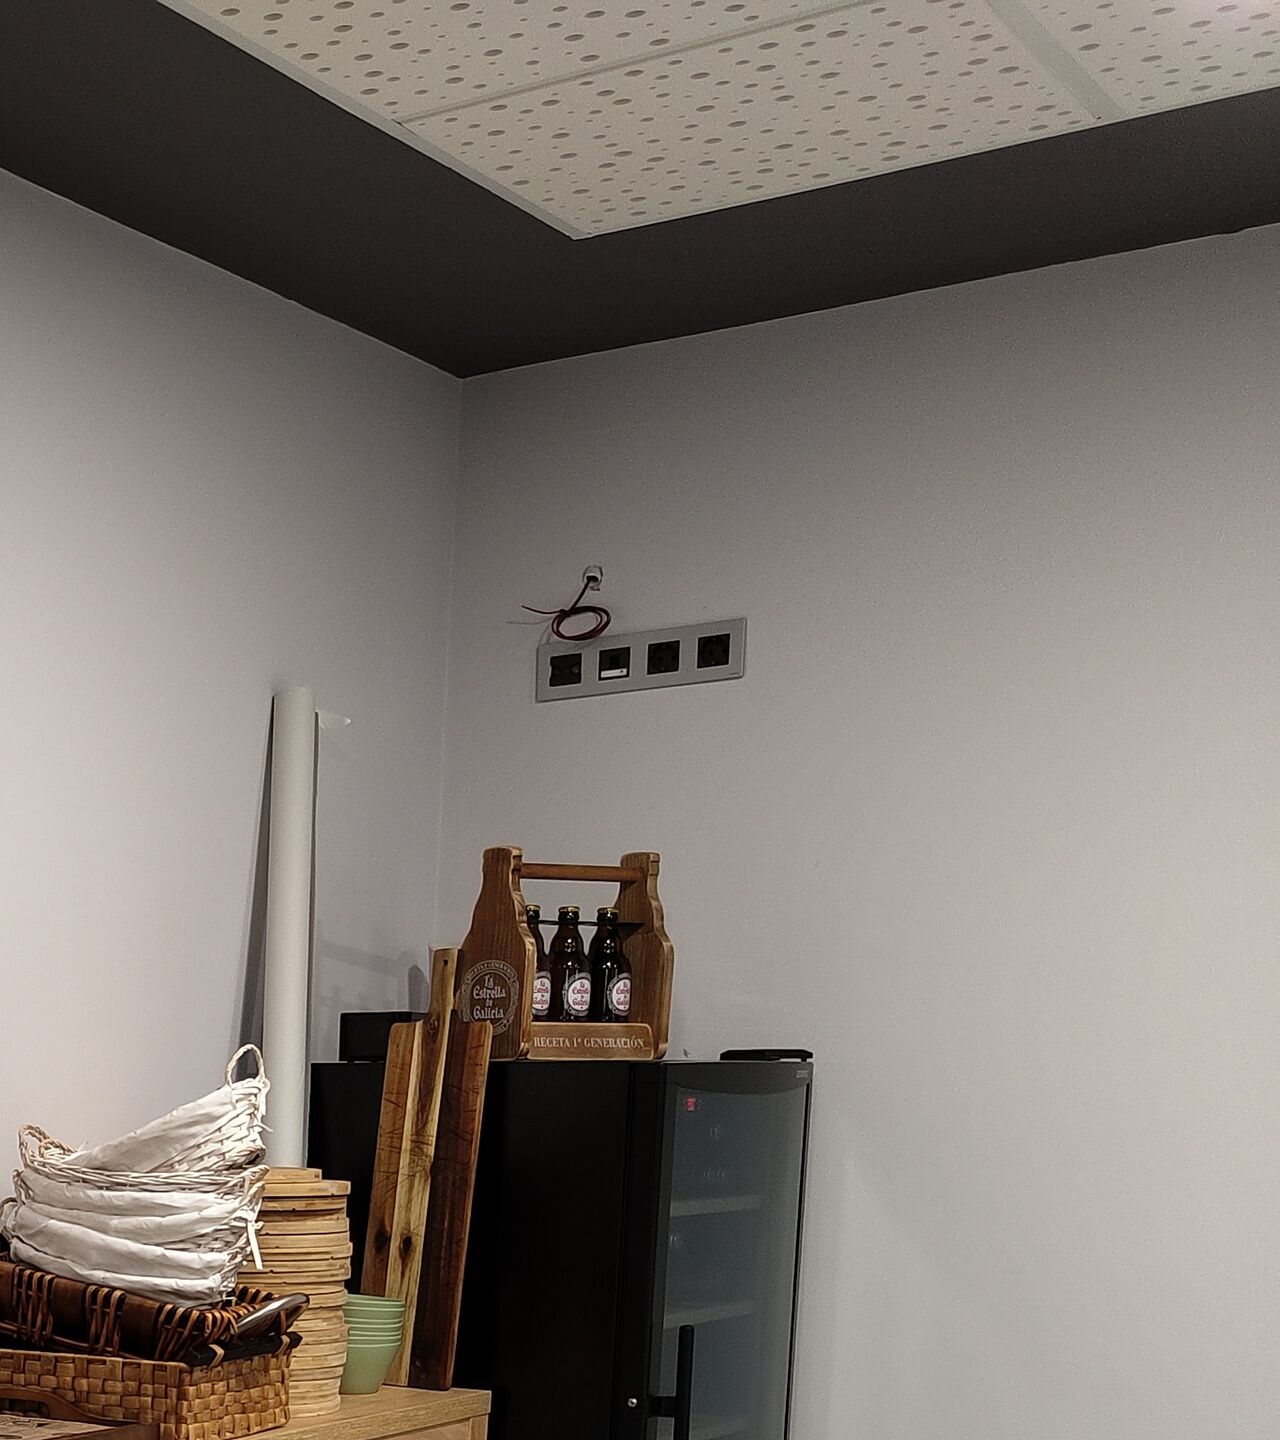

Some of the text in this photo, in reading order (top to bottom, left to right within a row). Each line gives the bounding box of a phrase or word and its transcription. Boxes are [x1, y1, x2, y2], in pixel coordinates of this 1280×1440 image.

[483, 974, 494, 989] La
[473, 984, 506, 999] Estrella
[473, 1005, 505, 1019] Galicia
[533, 1036, 570, 1048] RECETA
[583, 1034, 645, 1049] GENERACIÓN
